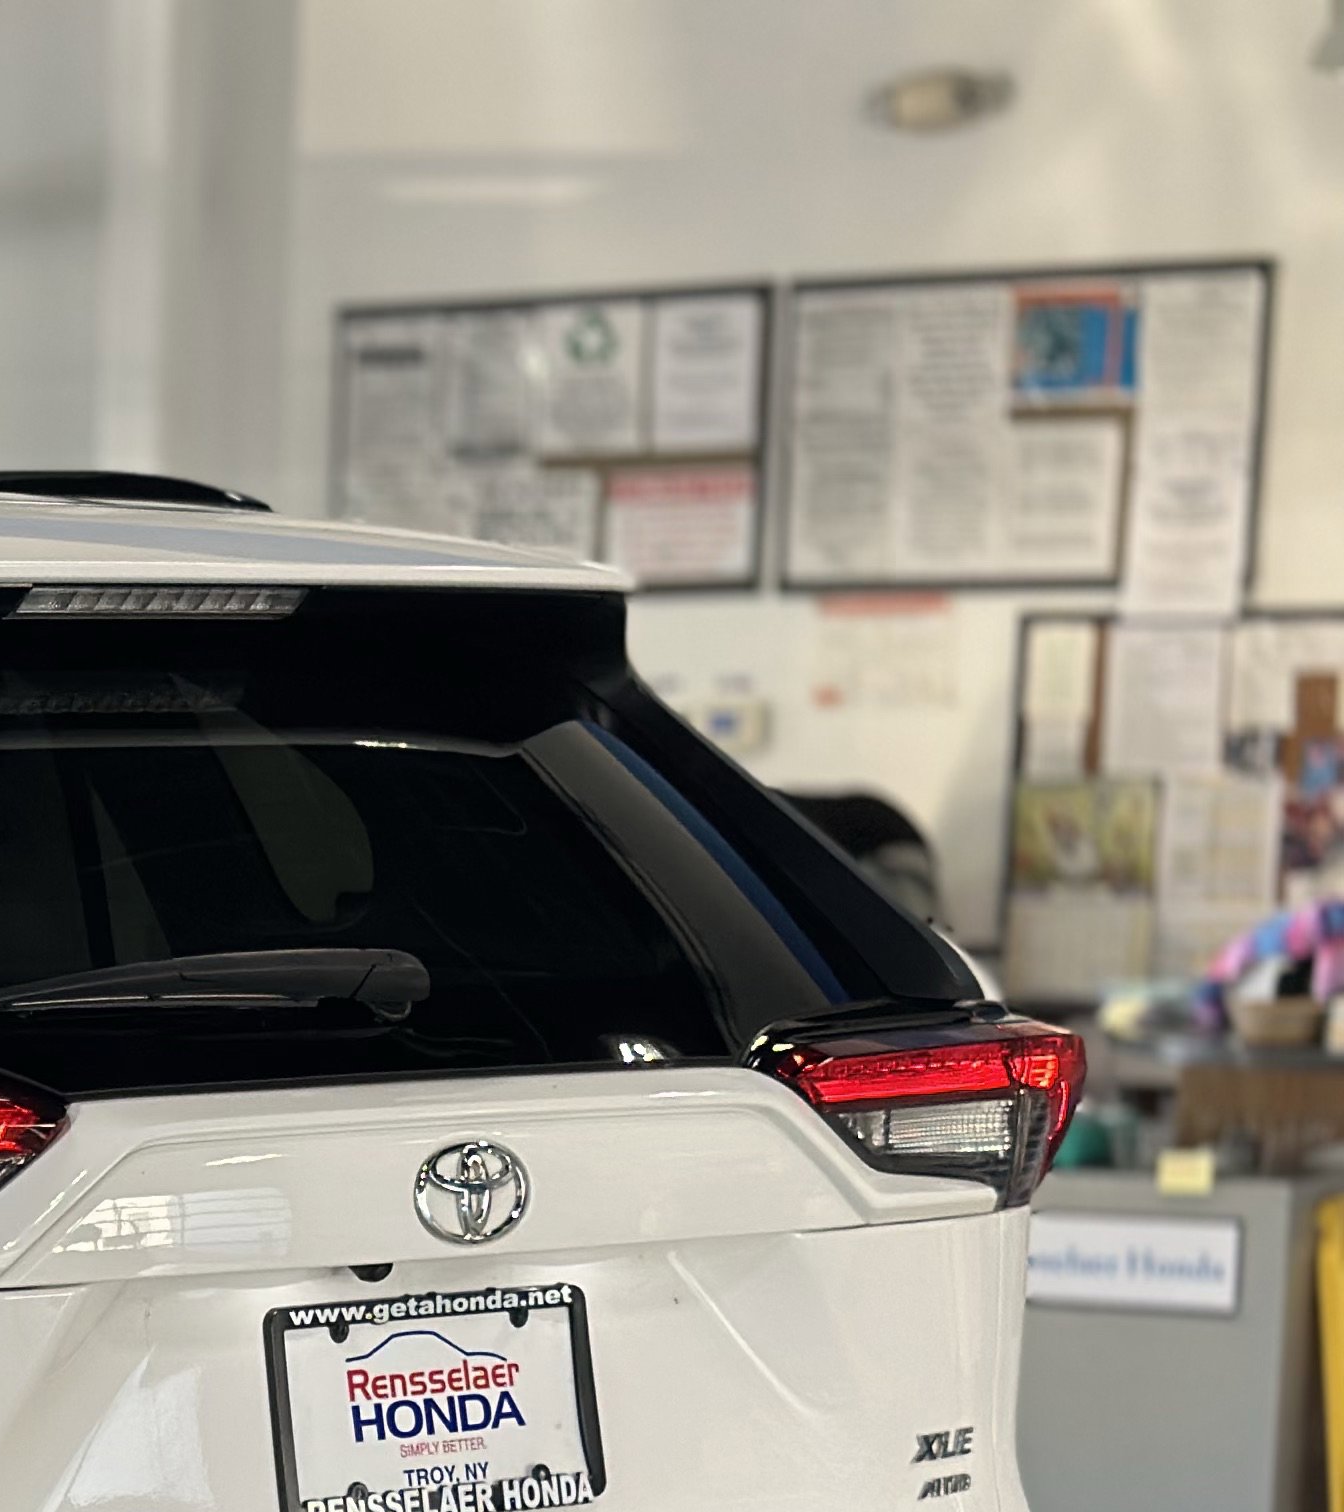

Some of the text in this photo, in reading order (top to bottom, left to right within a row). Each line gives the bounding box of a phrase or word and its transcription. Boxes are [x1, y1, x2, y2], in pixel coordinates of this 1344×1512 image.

[289, 1284, 572, 1326] www.getahonda.net
[346, 1359, 519, 1402] Rensselaer
[351, 1391, 526, 1442] HONDA
[400, 1441, 440, 1459] SIMPLY
[911, 1426, 974, 1464] XLE
[466, 1462, 489, 1481] NY
[502, 1471, 595, 1511] HONDA
[917, 1473, 972, 1501] AWD
